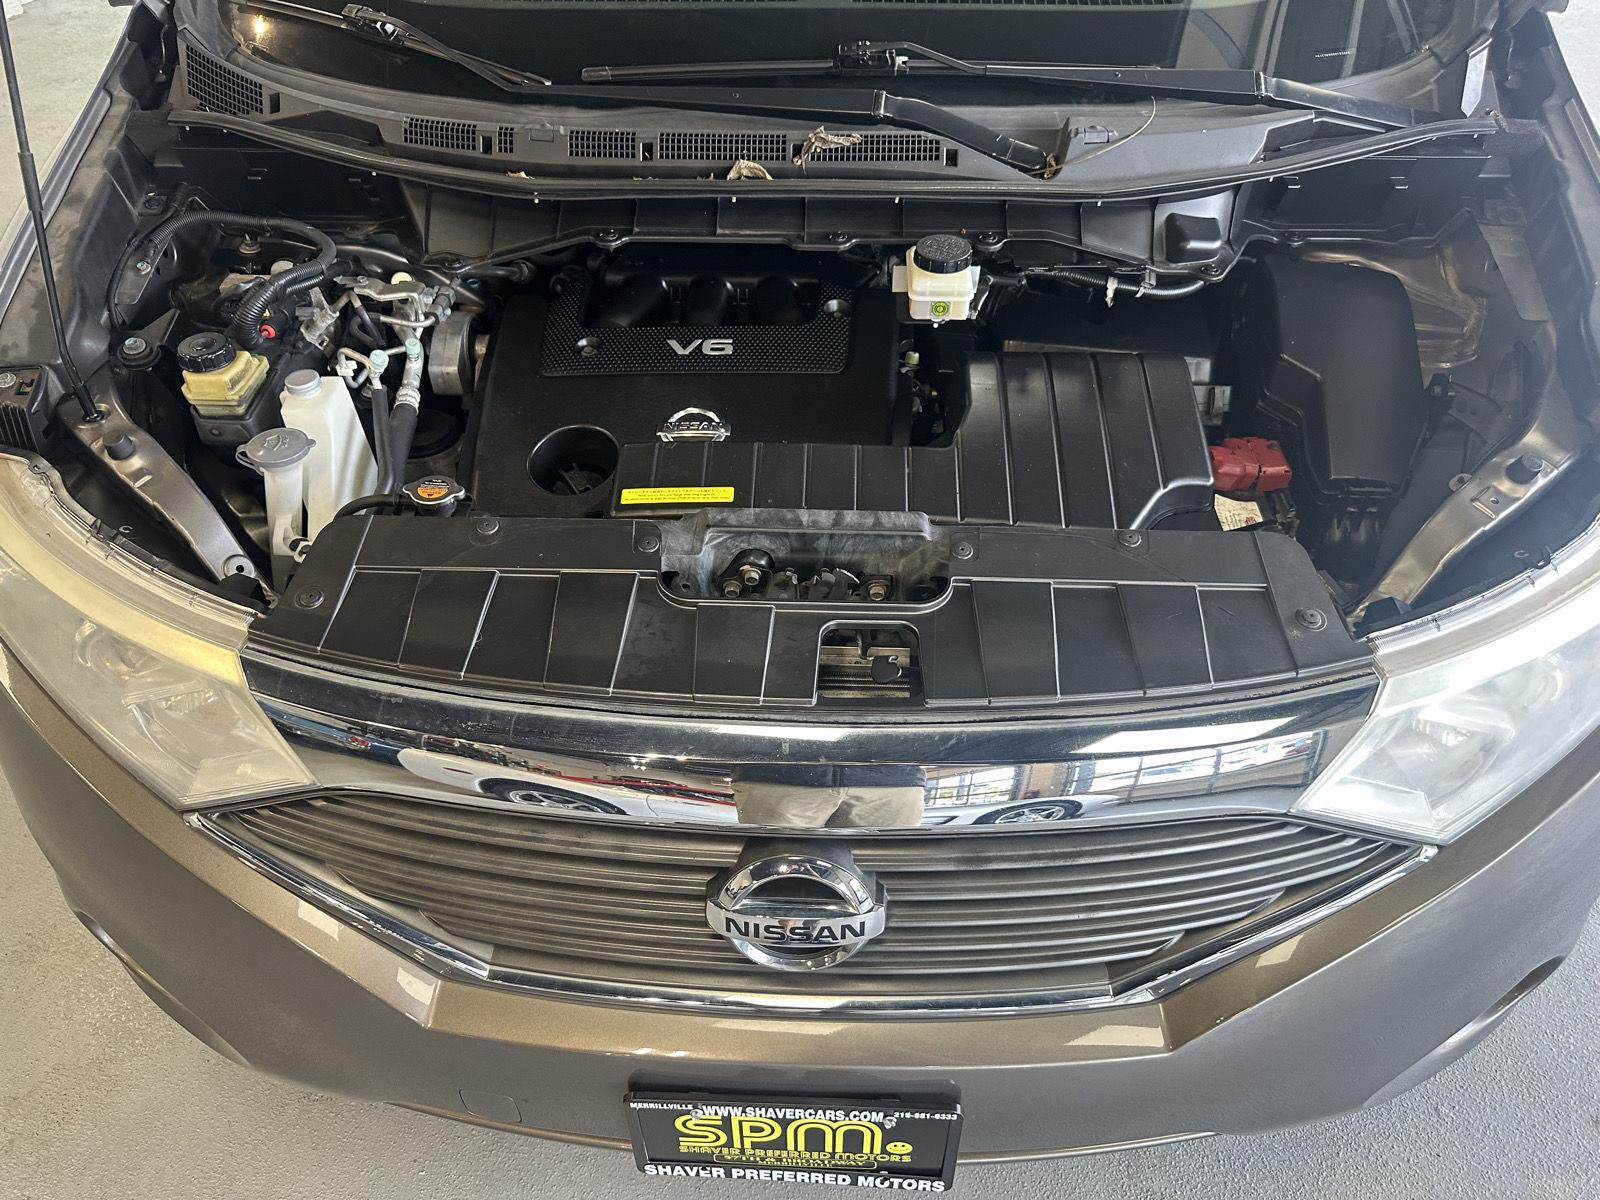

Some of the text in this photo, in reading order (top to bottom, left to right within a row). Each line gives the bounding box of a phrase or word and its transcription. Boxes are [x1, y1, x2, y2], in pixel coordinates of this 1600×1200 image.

[667, 339, 734, 355] V6
[664, 421, 725, 432] NISSAN
[725, 917, 865, 941] NISSAN
[629, 1102, 694, 1110] MERRILLVILLE
[702, 1106, 884, 1122] WWW.SHAVERCARS.COM
[678, 1145, 741, 1157] SHAVER
[744, 1148, 831, 1160] PREFERRED
[644, 1164, 946, 1193] SHAVER PREFERRED MOTORS
